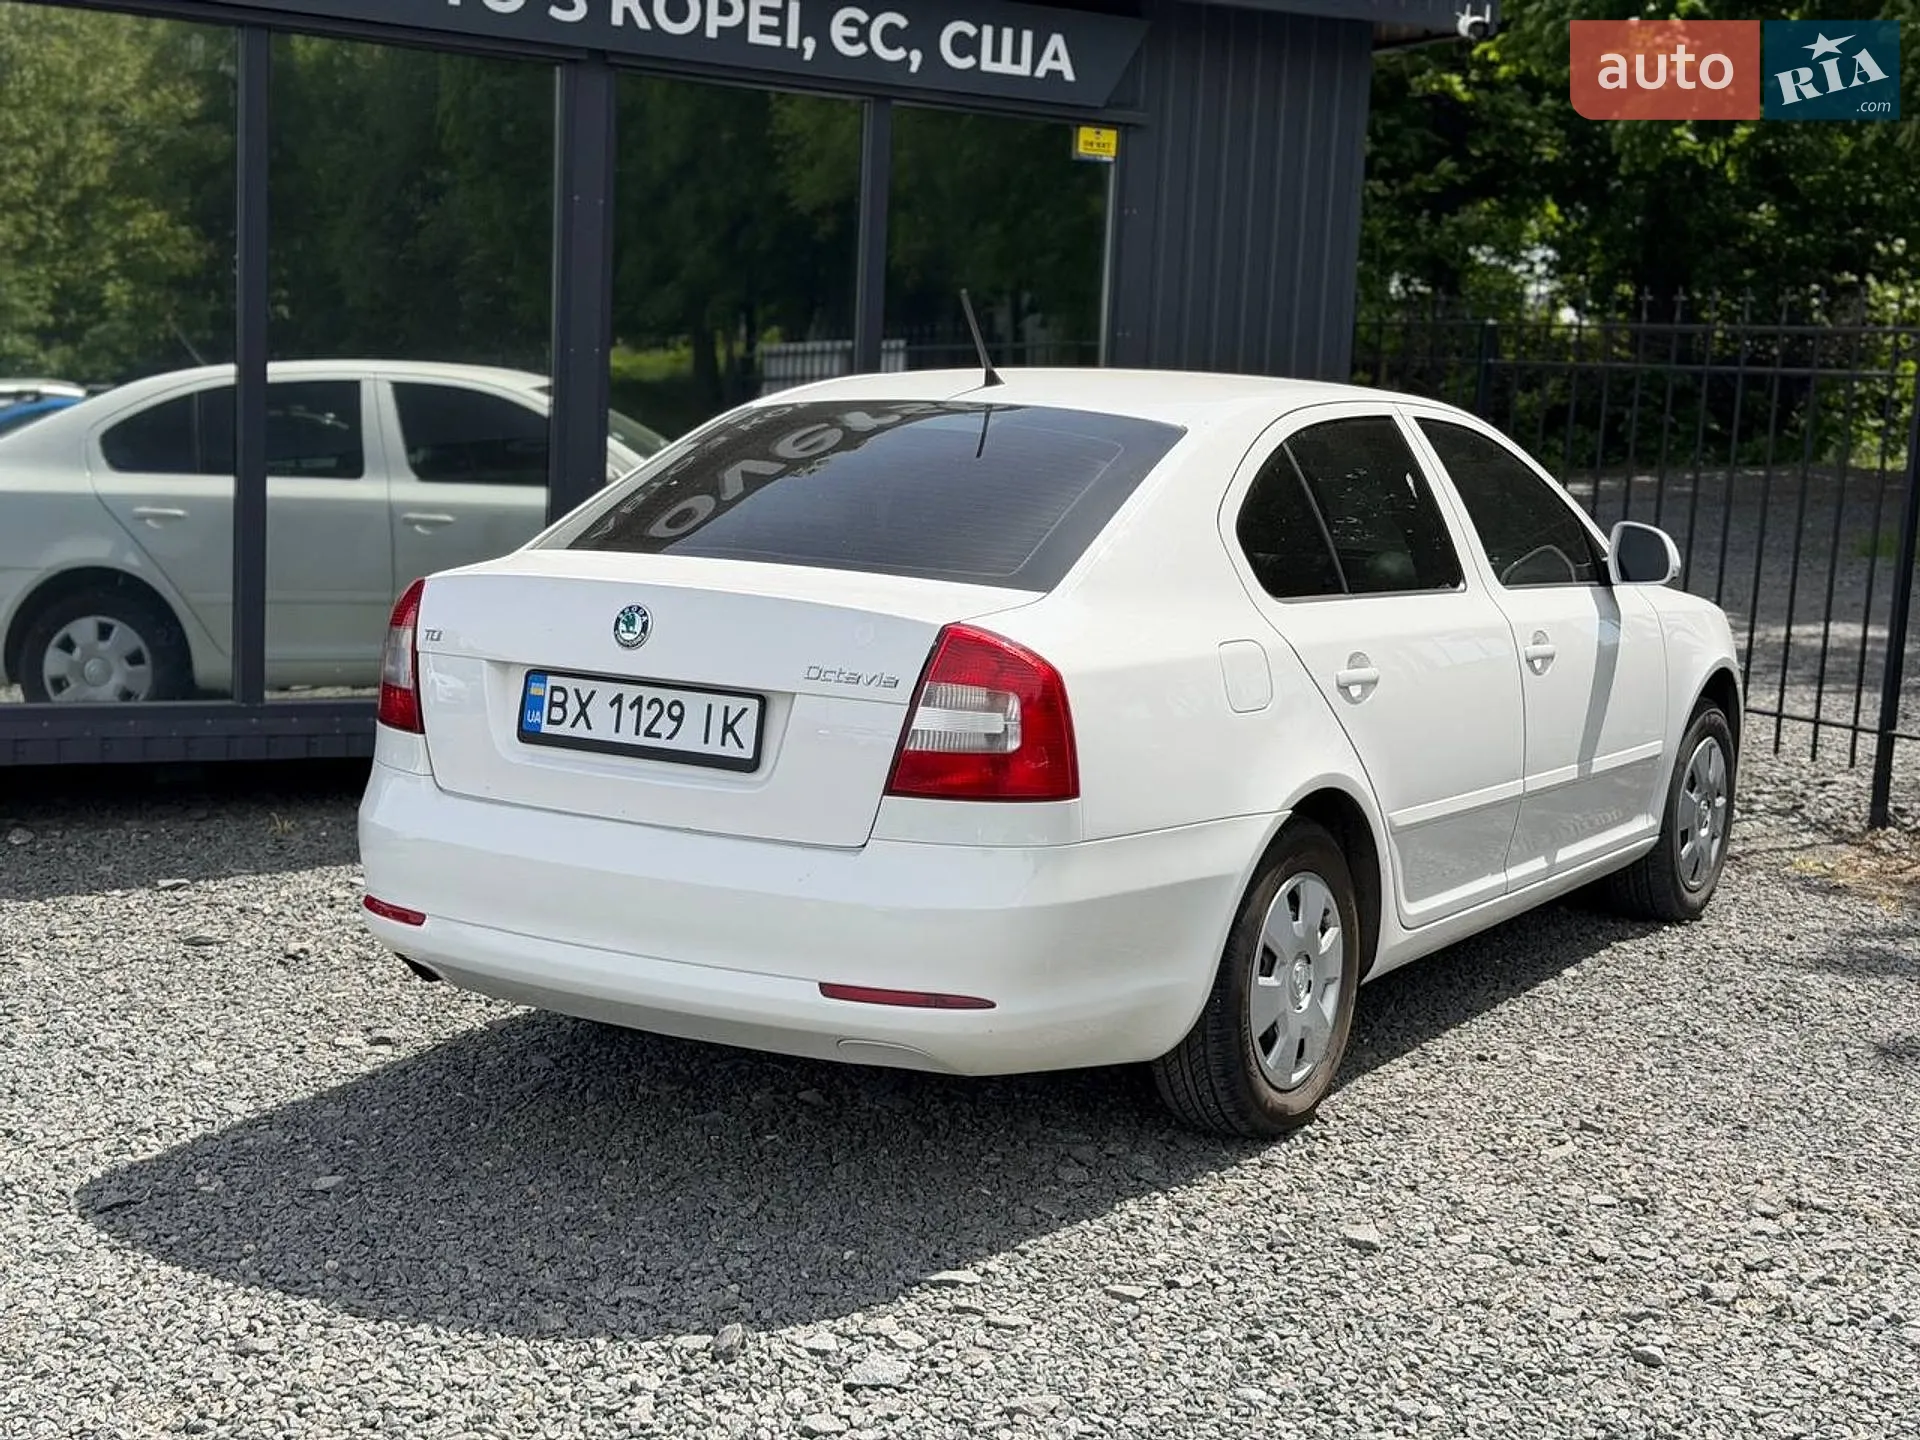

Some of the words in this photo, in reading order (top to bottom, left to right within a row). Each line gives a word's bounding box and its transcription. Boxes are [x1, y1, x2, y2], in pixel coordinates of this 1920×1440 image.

[830, 6, 923, 73] ЄС,
[939, 20, 1076, 82] США
[804, 665, 900, 689] Octavia
[526, 709, 541, 724] UA
[546, 685, 597, 730] BX
[608, 692, 685, 741] 1129
[703, 703, 749, 750] IK
